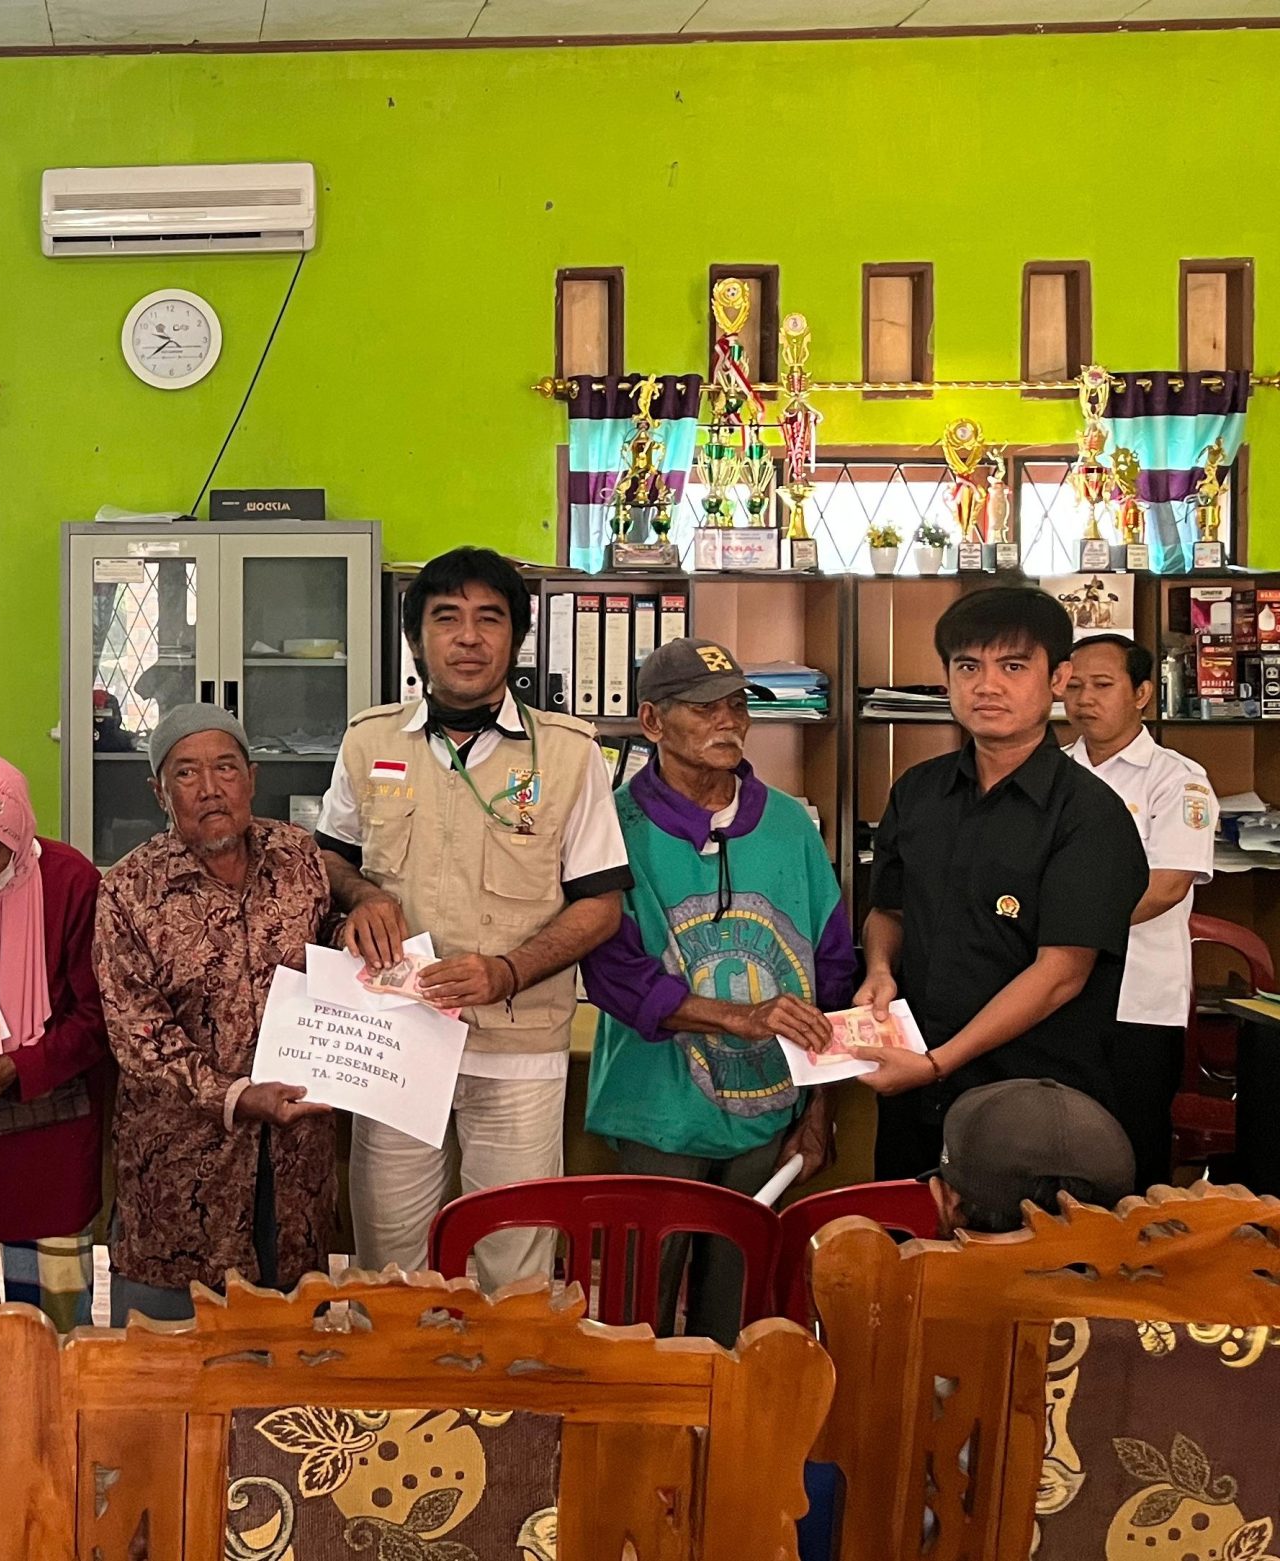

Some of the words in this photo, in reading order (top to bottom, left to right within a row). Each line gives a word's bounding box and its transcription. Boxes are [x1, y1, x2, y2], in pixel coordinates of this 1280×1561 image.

[314, 1004, 393, 1031] PEMBAGIAN
[297, 1016, 324, 1030] BLT
[327, 1023, 363, 1038] DANA
[368, 1032, 401, 1051] DESA
[309, 1036, 329, 1048] TW
[333, 1039, 341, 1049] 3
[345, 1041, 372, 1056] DAN
[376, 1050, 384, 1060] 4
[278, 1046, 312, 1061] (JULI
[326, 1053, 399, 1084] DESEMBER
[311, 1068, 331, 1079] TA.
[336, 1072, 369, 1088] 2025
